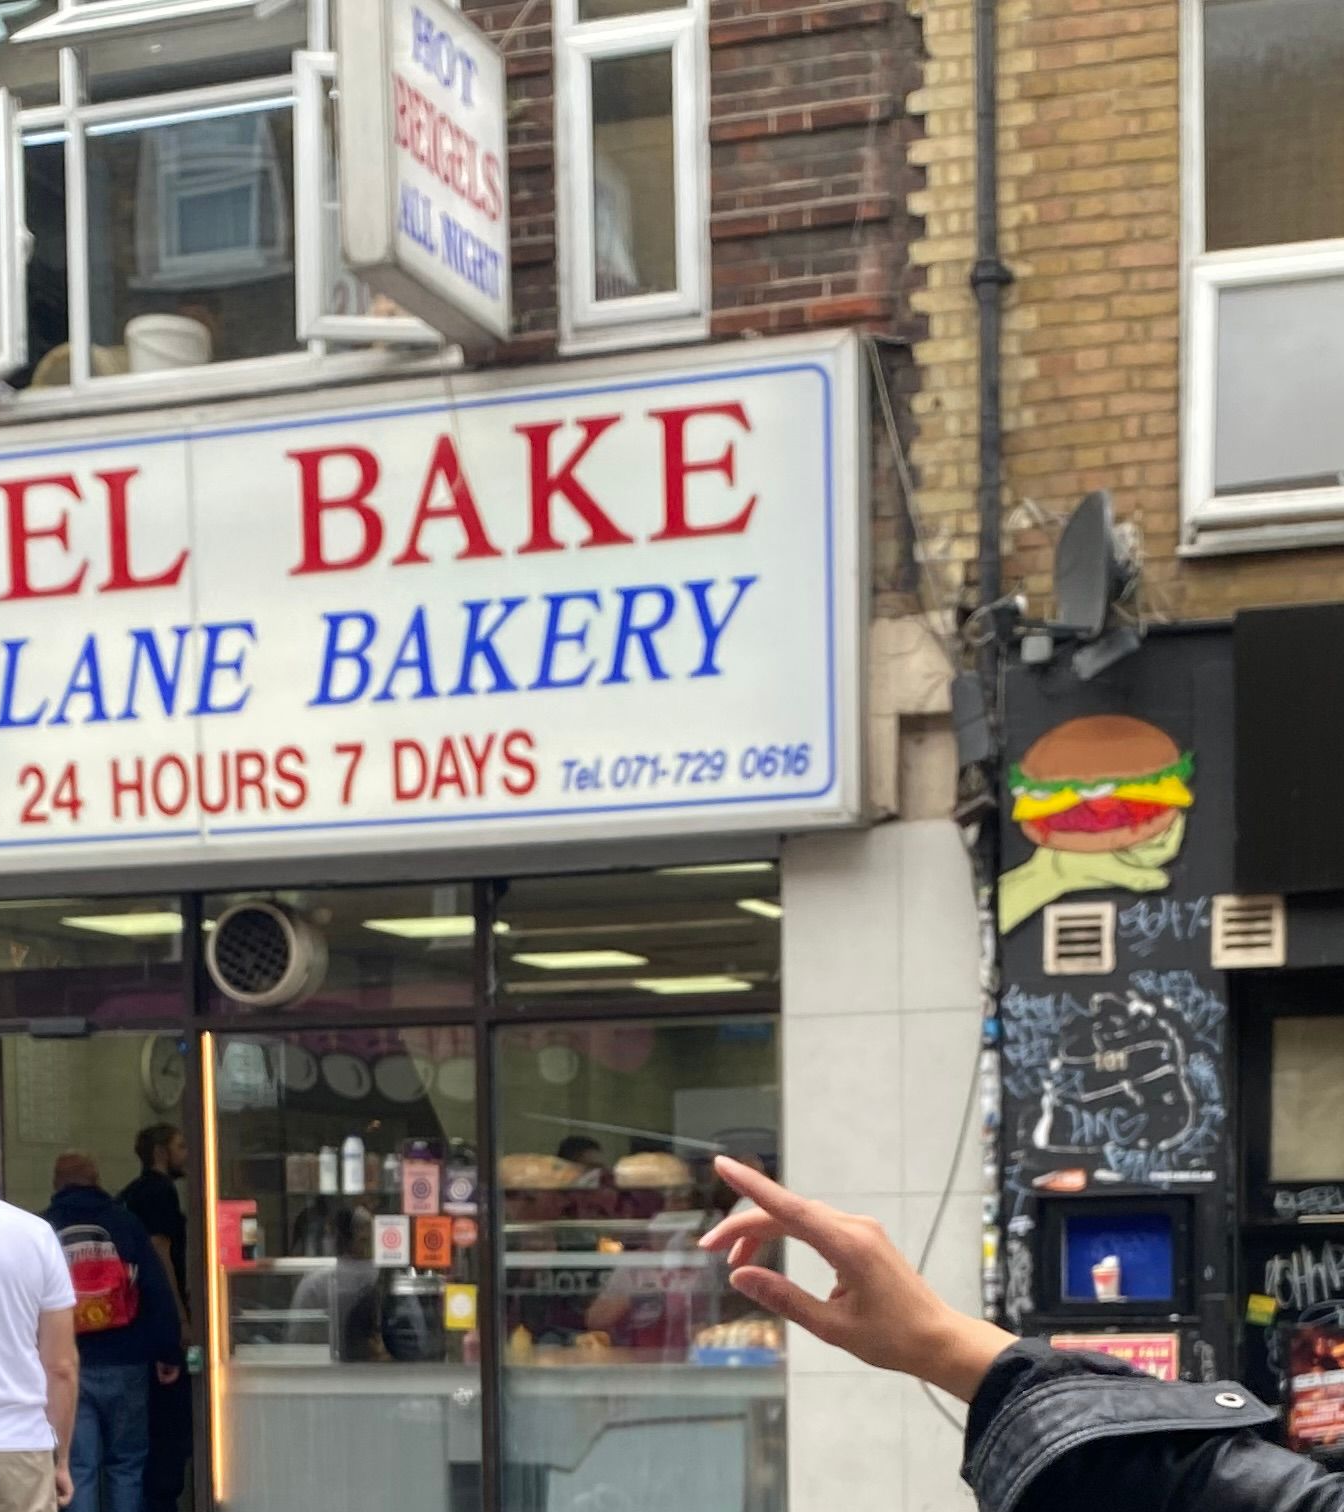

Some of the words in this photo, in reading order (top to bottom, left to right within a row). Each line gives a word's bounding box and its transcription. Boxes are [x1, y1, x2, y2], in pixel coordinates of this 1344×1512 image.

[412, 6, 478, 107] HOT
[392, 70, 504, 223] BEIGELS
[399, 178, 438, 256] ALL
[440, 210, 502, 301] NIGHT
[285, 400, 758, 577] BAKE
[308, 574, 759, 708] BAKERY
[17, 762, 83, 826] 24
[111, 745, 309, 819] HOURS
[332, 743, 366, 806] 7
[391, 729, 538, 803] DAYS
[739, 743, 811, 781] 0616
